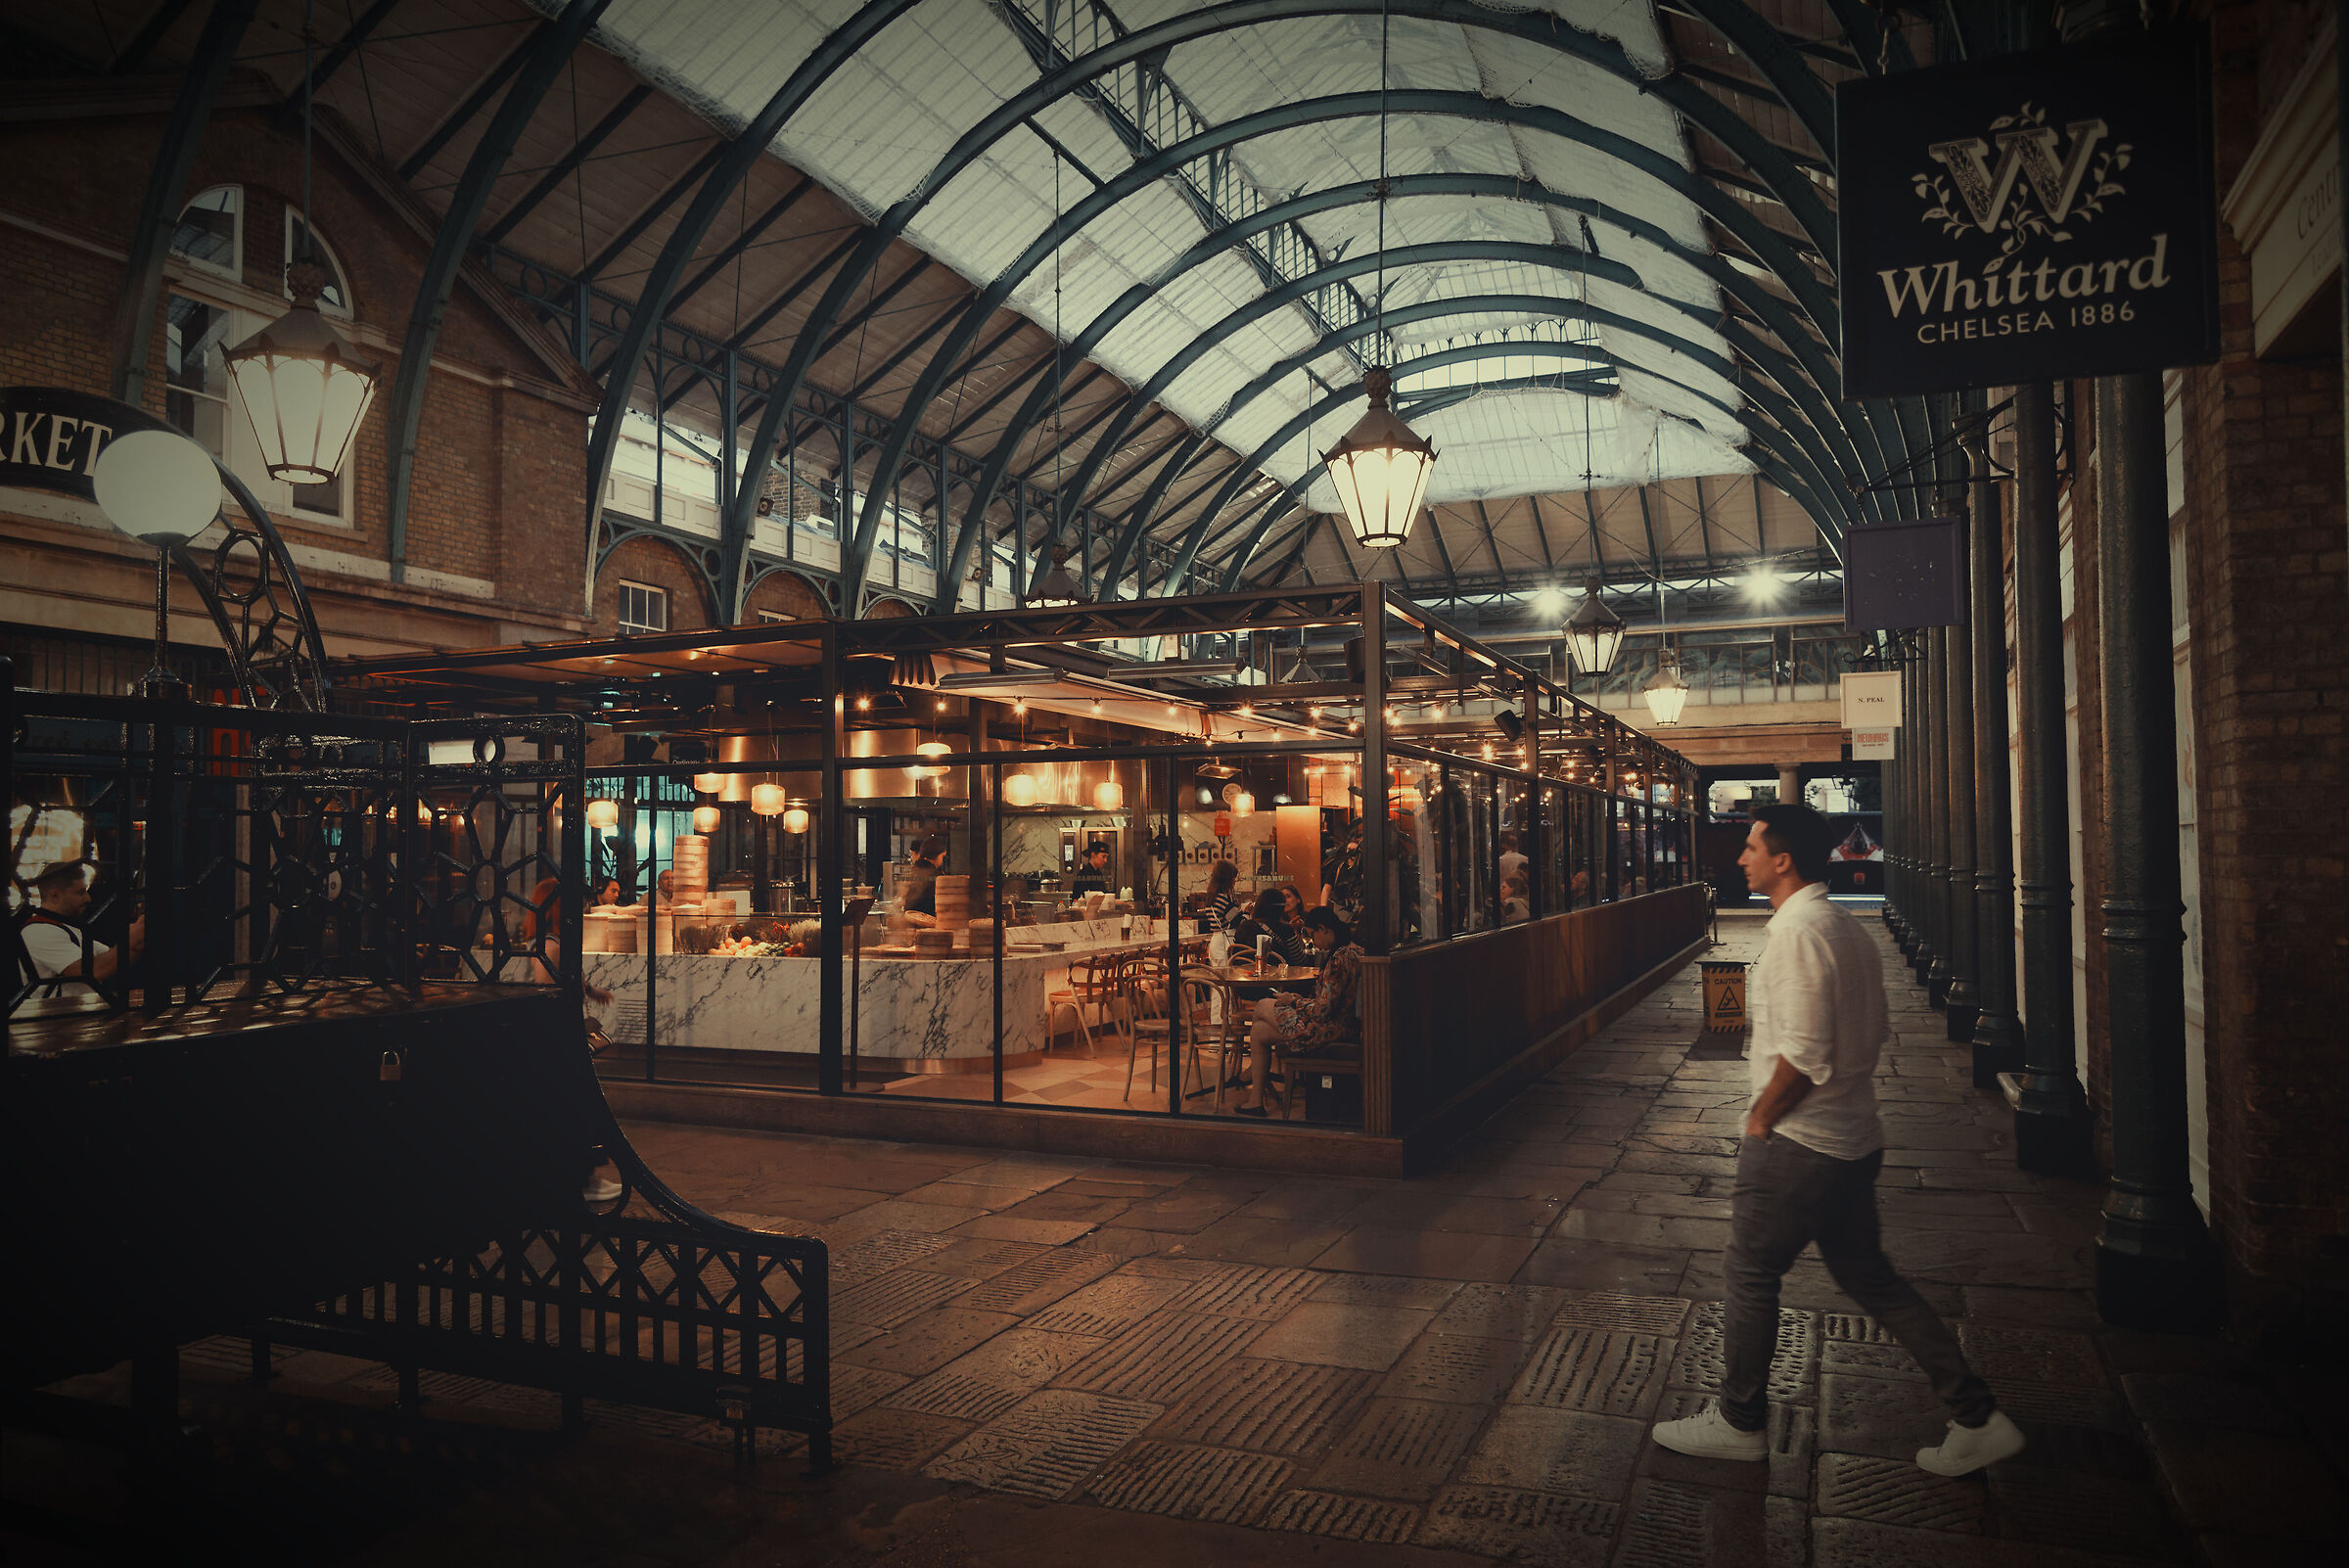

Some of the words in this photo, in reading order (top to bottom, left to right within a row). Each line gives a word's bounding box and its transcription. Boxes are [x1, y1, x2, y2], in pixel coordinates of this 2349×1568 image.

[1876, 232, 2171, 319] Whittard
[1916, 310, 2055, 345] CHELSEA
[2070, 300, 2136, 329] 1886
[0, 411, 114, 478] KET
